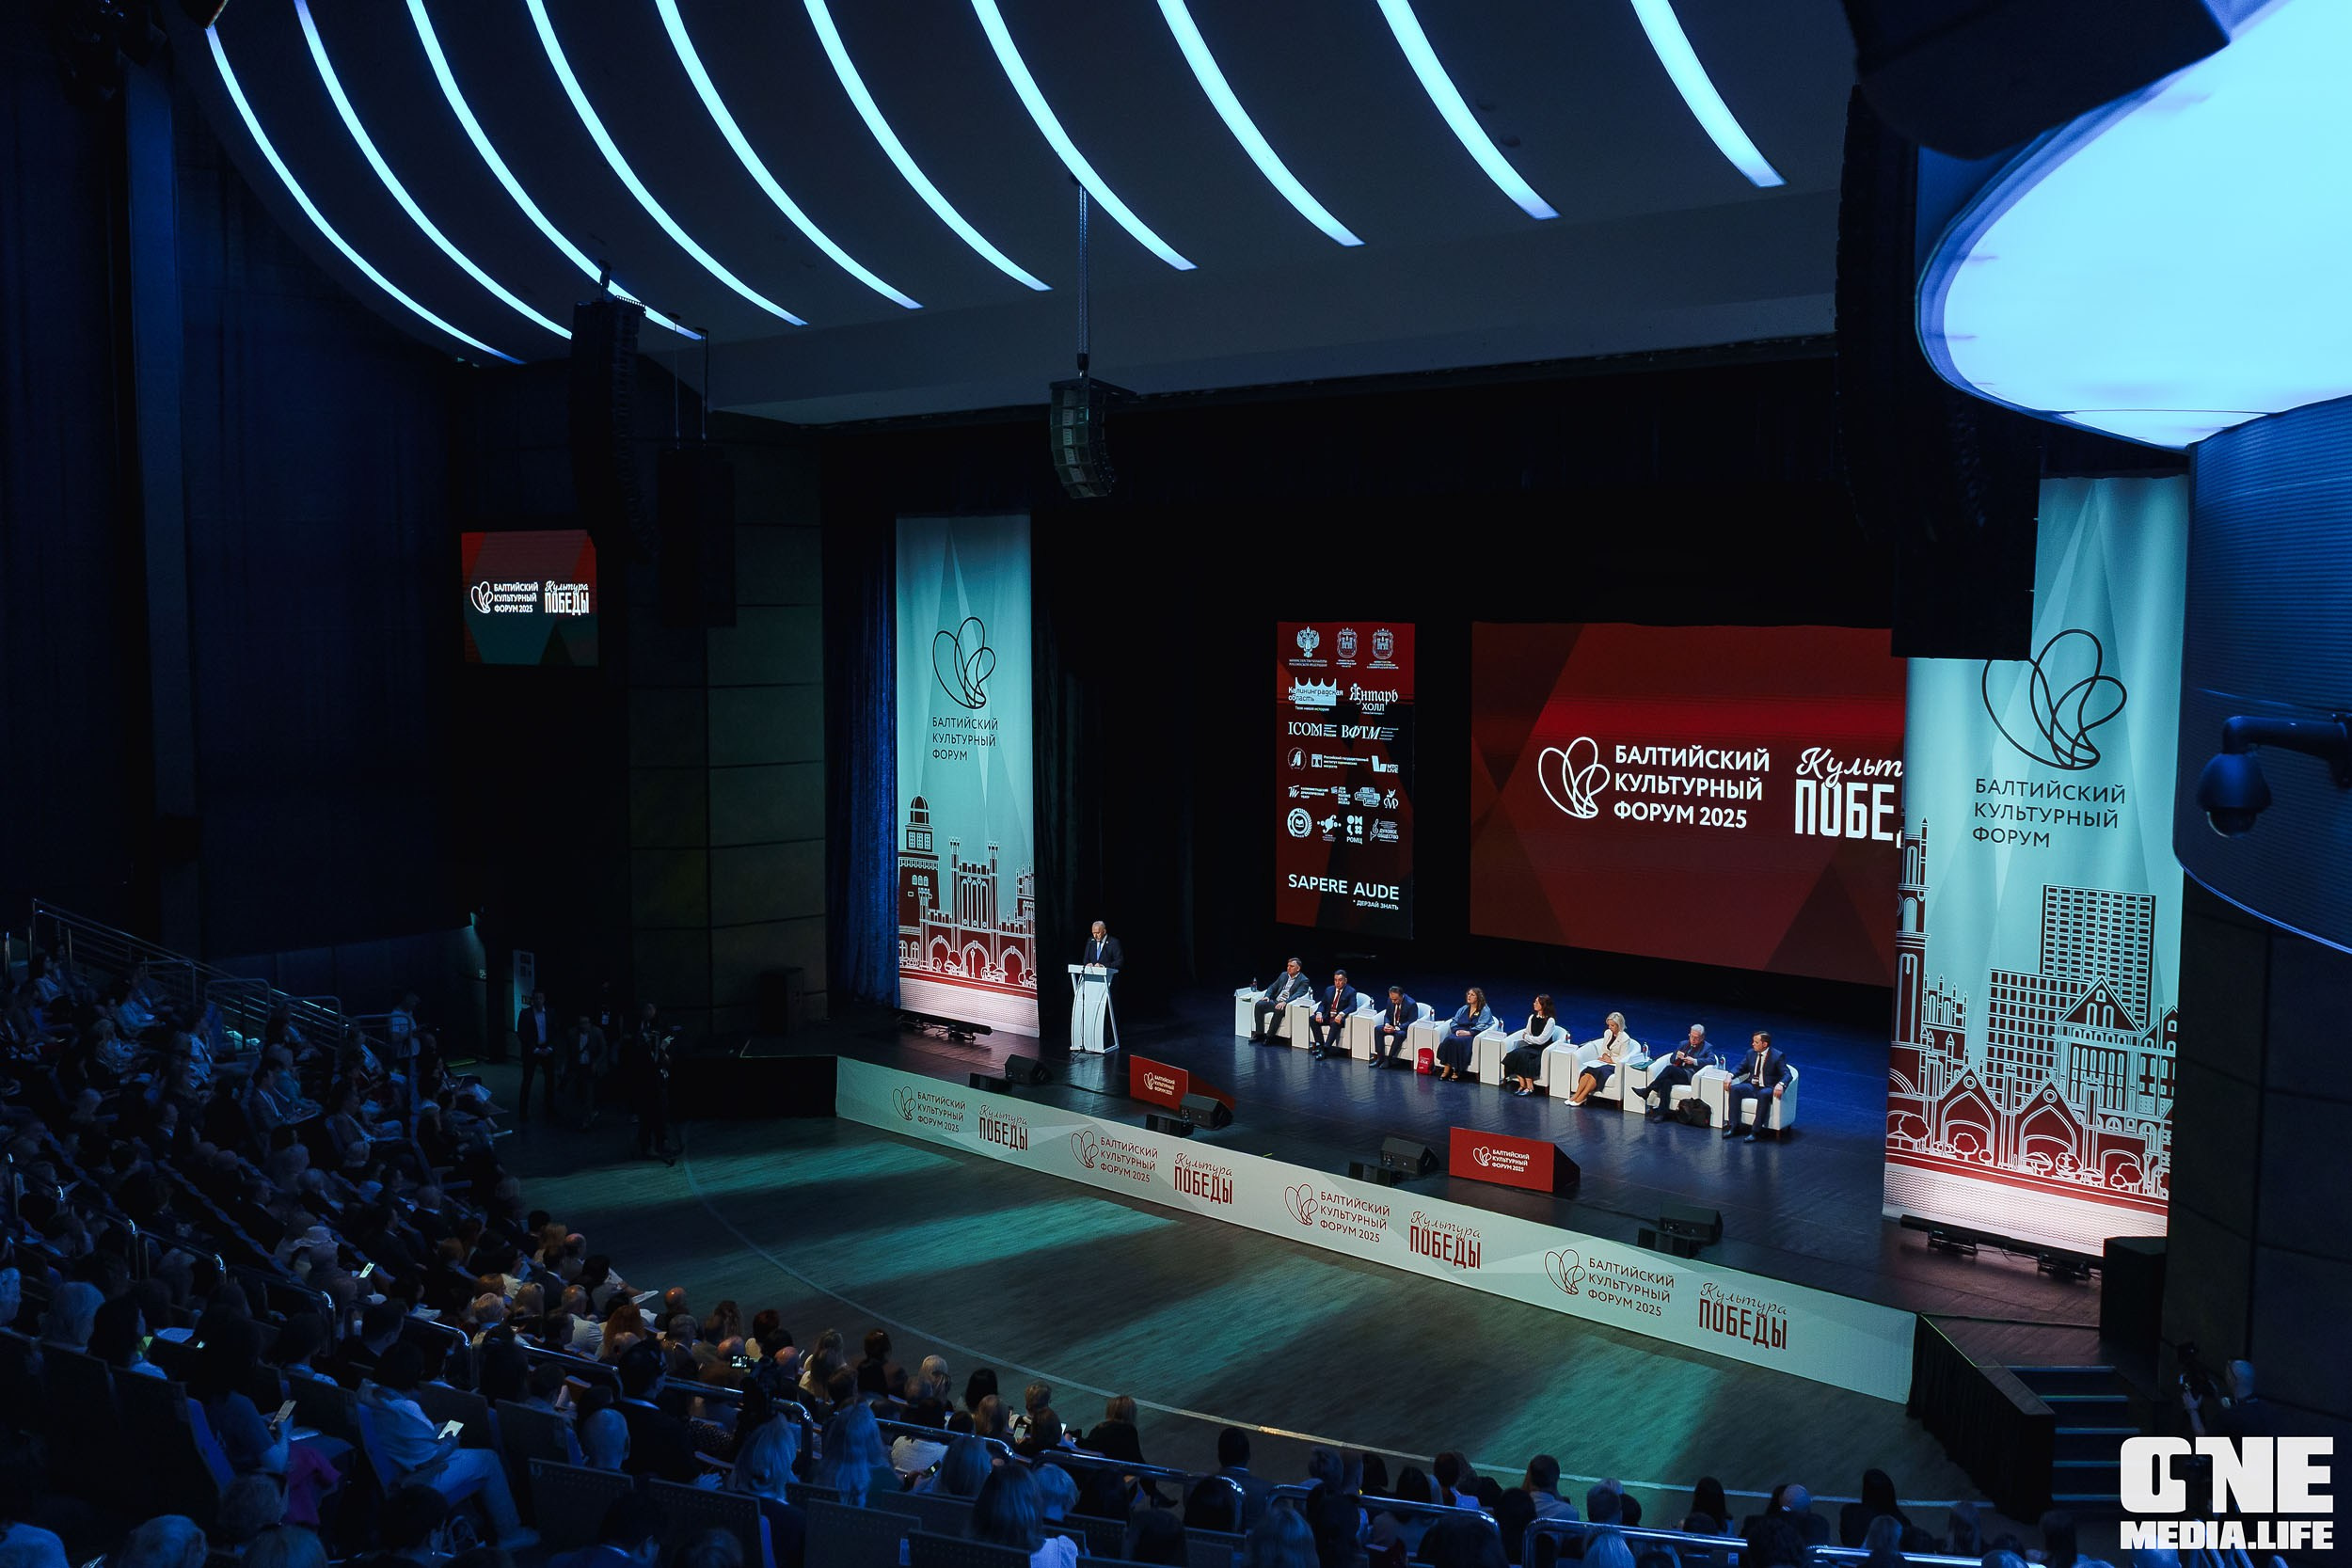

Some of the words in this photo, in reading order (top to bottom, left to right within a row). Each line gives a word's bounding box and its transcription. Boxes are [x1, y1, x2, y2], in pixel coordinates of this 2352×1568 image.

[494, 582, 538, 592] БАЛТИЙСКИЙ
[494, 593, 537, 602] КУЛЬТУРНЫЙ
[545, 580, 589, 595] Культура
[545, 593, 590, 615] ПОБЕДЫ
[1288, 687, 1343, 696] Калининградская
[1362, 703, 1384, 711] ХОЛЛ
[932, 716, 998, 730] БАЛТИЙСКИЙ
[1288, 721, 1322, 736] ICOM
[932, 733, 996, 747] КУЛЬТУРНЫЙ
[932, 749, 968, 761] ФОРУМ
[1615, 744, 1770, 772] БАЛТИЙСКИЙ
[1615, 773, 1763, 800] КУЛЬТУРНЫЙ
[1976, 778, 2125, 804] БАЛТИЙСКИЙ
[1613, 800, 1694, 824] ФОРУМ
[1699, 806, 1747, 829] 2025
[1975, 801, 2118, 829] КУЛЬТУРНЫЙ
[1973, 827, 2050, 847] ФОРУМ
[1288, 874, 1347, 894] SAPERE
[1353, 882, 1399, 900] AUDE
[917, 1091, 966, 1111] БАЛТИЙСКИЙ
[917, 1102, 964, 1121] КУЛЬТУРНЫЙ
[917, 1116, 943, 1130] ФОРУМ
[945, 1123, 960, 1133] 2025
[978, 1104, 1028, 1126] Культура
[978, 1117, 1028, 1151] ПОБЕДЫ
[1101, 1136, 1158, 1159] БАЛТИЙСКИЙ
[1101, 1150, 1155, 1171] КУЛЬТУРНЫЙ
[1174, 1152, 1232, 1177] Культура
[1100, 1163, 1131, 1179] ФОРУМ
[1133, 1171, 1151, 1183] 2025
[1174, 1165, 1233, 1205] ПОБЕДЫ
[1320, 1191, 1391, 1217] БАЛТИЙСКИЙ
[1320, 1205, 1387, 1230] КУЛЬТУРНЫЙ
[1410, 1211, 1481, 1241] Культура
[1320, 1219, 1357, 1237] ФОРУМ
[1359, 1228, 1380, 1243] 2025
[1410, 1226, 1481, 1270] ПОБЕДЫ
[1589, 1258, 1675, 1288] БАЛТИЙСКИЙ
[1588, 1274, 1671, 1303] КУЛЬТУРНЫЙ
[1700, 1282, 1788, 1316] Культура
[1588, 1289, 1632, 1309] ФОРУМ
[1636, 1300, 1662, 1317] 2025
[1699, 1298, 1787, 1350] ПОБЕДЫ
